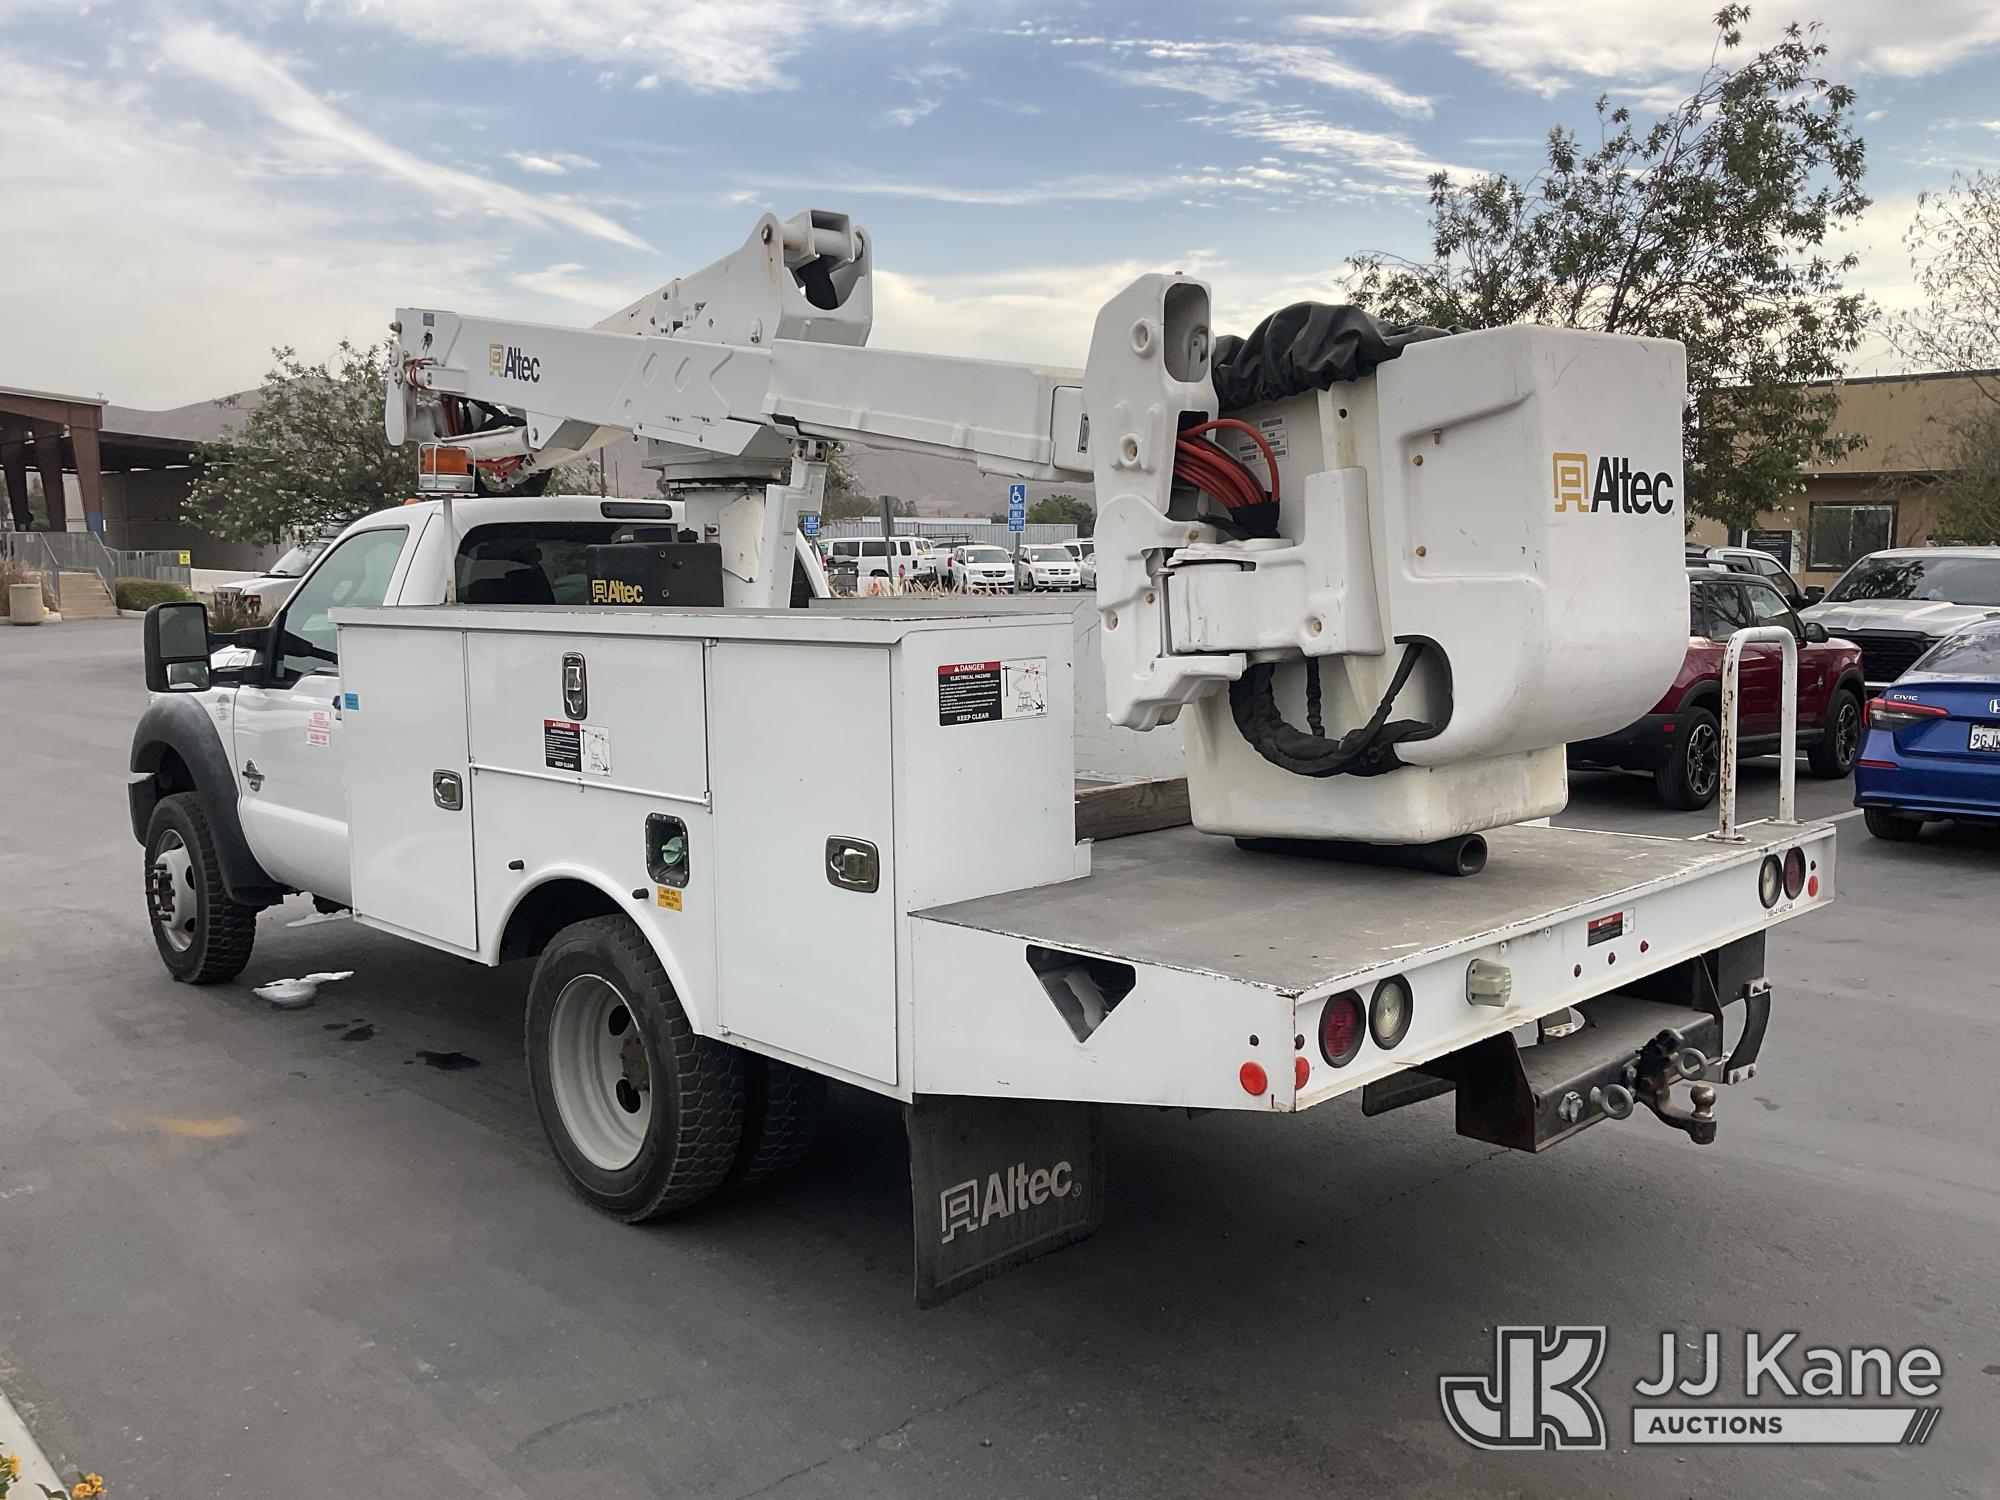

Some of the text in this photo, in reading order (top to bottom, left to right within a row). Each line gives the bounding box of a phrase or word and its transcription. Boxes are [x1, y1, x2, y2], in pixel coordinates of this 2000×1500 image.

[504, 346, 540, 383] Altec
[1591, 456, 1674, 515] Altec
[607, 580, 644, 603] Altec
[960, 663, 985, 672] DANGER
[957, 714, 971, 722] KEEP
